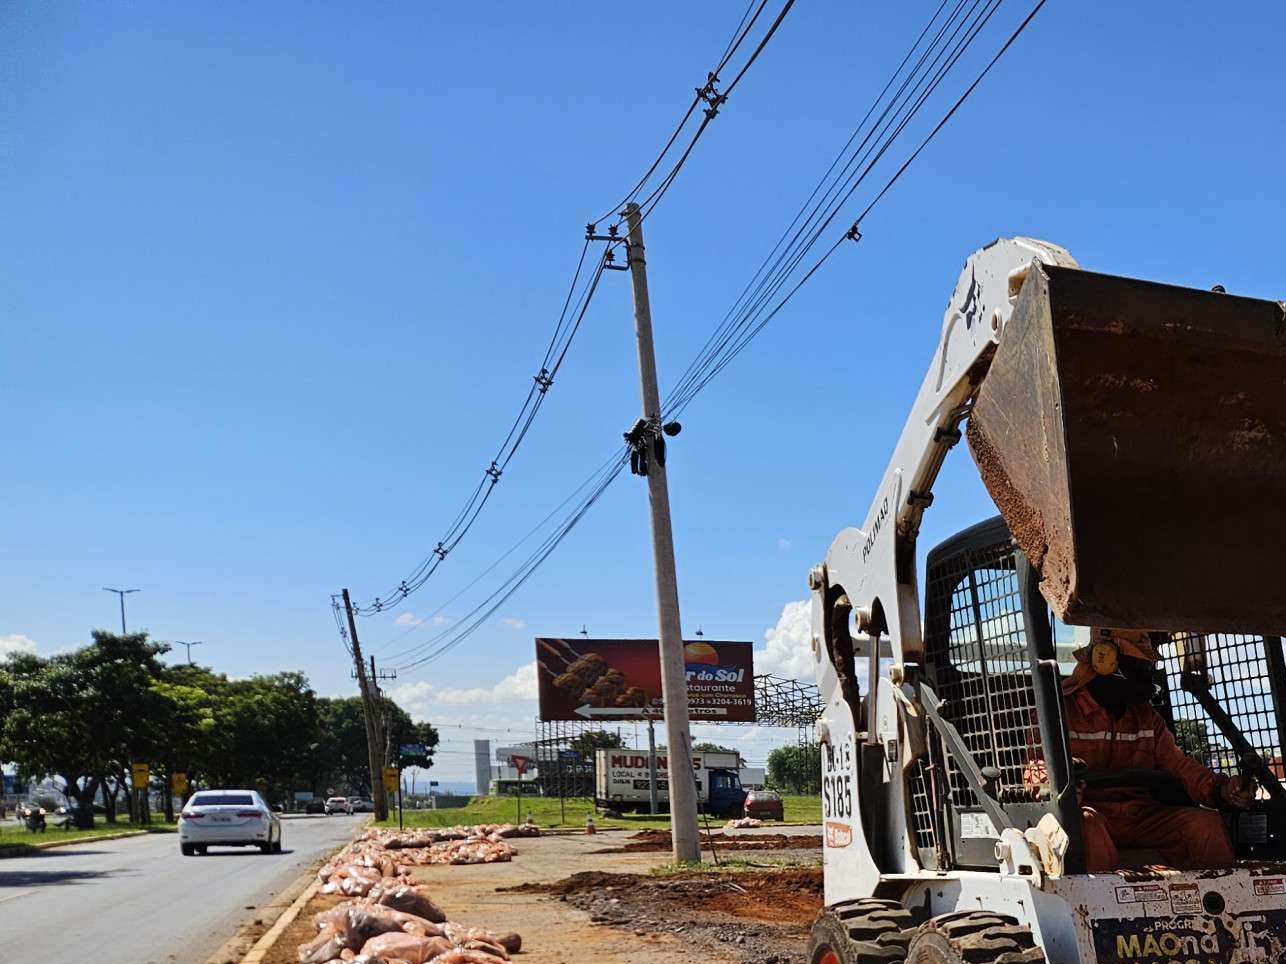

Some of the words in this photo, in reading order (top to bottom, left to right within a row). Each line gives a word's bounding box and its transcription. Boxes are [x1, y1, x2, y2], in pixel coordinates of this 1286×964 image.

[697, 671, 713, 681] do
[714, 668, 745, 683] Sol
[823, 775, 852, 818] S185
[1154, 919, 1193, 931] PROGR
